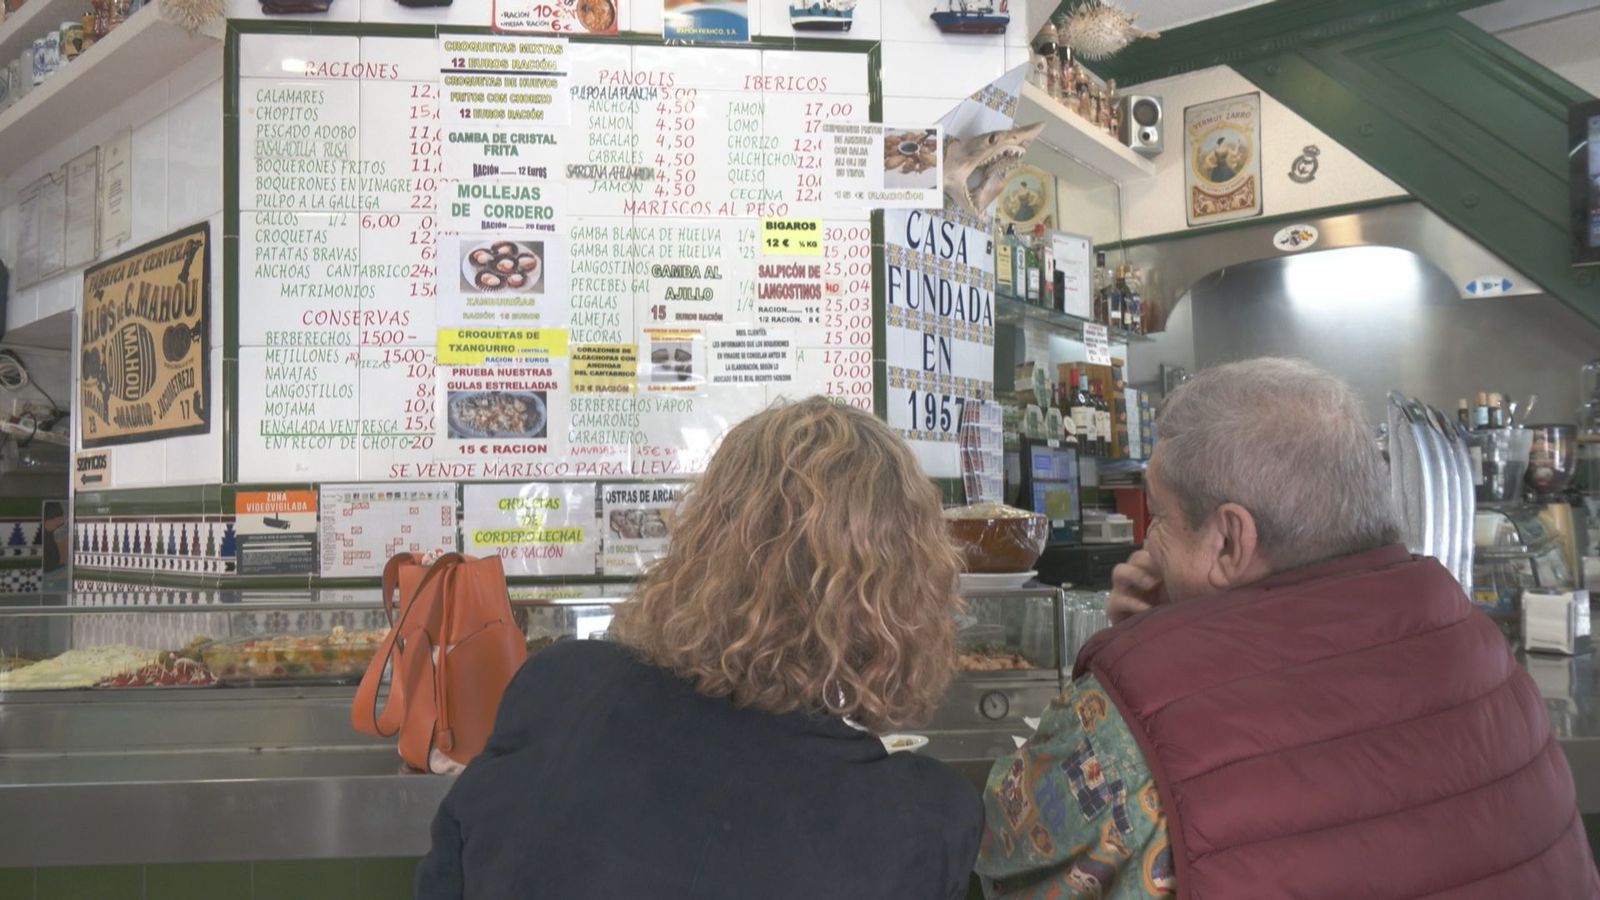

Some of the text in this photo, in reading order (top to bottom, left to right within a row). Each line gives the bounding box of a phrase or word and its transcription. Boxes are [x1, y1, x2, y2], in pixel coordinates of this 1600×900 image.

[444, 41, 563, 54] CROQUETAS MIXTAS
[305, 61, 399, 79] RACIONES
[452, 58, 508, 68] 12 EUROS
[445, 76, 502, 86] CROQUETAS
[504, 77, 517, 86] DE
[599, 70, 675, 87] PANOLIS
[744, 75, 827, 92] IBERICOS
[257, 89, 324, 104] CALAMARES
[450, 92, 552, 104] FRITOS CON CHORIZO
[257, 107, 318, 121] CHOPITOS
[460, 108, 505, 118] 12 EUROS
[589, 101, 639, 114] ANCHOAS
[727, 102, 852, 118] JAMON 17,00
[589, 116, 632, 129] SALMON
[1226, 112, 1251, 120] ZARRO
[257, 125, 356, 139] PESCADO ADOBO
[728, 119, 758, 132] LOMO
[449, 132, 557, 144] GAMBA DE CRISTAL
[589, 132, 639, 147] BACALAO
[728, 136, 779, 150] CHORIZO
[484, 145, 519, 156] FRITA
[589, 150, 643, 164] CABRALES
[728, 152, 797, 166] SALCHICHON
[256, 160, 386, 174] BOQUERONES FRITOS
[518, 167, 525, 175] 12
[728, 169, 765, 184] QUESO
[256, 178, 412, 192] BOQUERONES EN VINAGRE
[458, 184, 540, 200] MOLLEJAS
[589, 181, 642, 193] JAMON
[256, 194, 380, 209] PULPO A LA GALLEGA
[730, 189, 783, 200] CECINA
[452, 203, 553, 219] DE CORDERO
[624, 199, 788, 217] MARISCOS AL PESO
[256, 212, 298, 226] CALLOS
[362, 215, 400, 229] 6,00
[766, 222, 816, 230] BIGAROS
[256, 230, 328, 243] CROQUETAS
[571, 226, 870, 241] GAMBA BLANCA DE HUELVA 30,00
[907, 210, 967, 264] CASA
[766, 239, 779, 247] 12
[782, 239, 789, 247] €
[256, 247, 357, 261] PATATAS BRAVAS
[571, 244, 608, 257] GAMBA
[613, 244, 654, 258] BLANCA
[659, 245, 673, 258] DE
[678, 245, 721, 258] HUELVA
[256, 264, 410, 278] ANCHOAS CANTABRICO
[571, 261, 649, 275] LANGOSTINOS
[652, 264, 722, 279] GAMBA AL
[759, 262, 820, 278] SALPICÓN DE
[281, 284, 376, 298] MATRIMONIOS
[572, 278, 626, 292] PERCEBES
[758, 283, 821, 299] LANGOSTINOS
[665, 287, 713, 301] AJILLO
[889, 264, 992, 326] FUNDADA
[571, 296, 617, 308] CIGALAS
[302, 310, 410, 326] CONSERVAS
[651, 305, 666, 320] 15
[571, 313, 620, 328] ALMEJAS
[266, 331, 351, 346] BERBERECHOS
[458, 330, 539, 339] CROQUETAS DE
[571, 330, 622, 342] NECORAS
[449, 344, 515, 352] TXANGURRO
[924, 333, 952, 374] EN
[124, 326, 140, 398] MAHOU
[266, 349, 339, 364] MEJILLONES
[355, 359, 391, 369] PIEZAS
[265, 367, 317, 382] NAVAJAS
[453, 368, 552, 376] PRUEBA NUESTRAS
[266, 384, 353, 398] LANGOSTILLOS
[448, 382, 558, 390] GULAS ESTRELLADAS
[180, 400, 190, 420] 17
[265, 402, 315, 417] MOJAMA
[570, 399, 693, 412] BERBERECHOS VAPOR
[908, 390, 965, 433] 1957
[265, 420, 398, 433] ENSALADA VENTRESCA
[572, 414, 640, 427] CAMARONES
[265, 437, 409, 449] ENTRECOT DE CHOTO
[568, 431, 648, 444] CARABINEROS
[459, 445, 547, 454] 15 € RACION
[77, 454, 107, 471] SERVICIOS
[389, 462, 623, 478] SE VENDE MARISCO PARA
[267, 492, 287, 502] ZONA
[606, 490, 650, 504] OSTRAS DE
[246, 502, 307, 512] VIDEOVIGILADA
[539, 529, 582, 542] LECHAL
